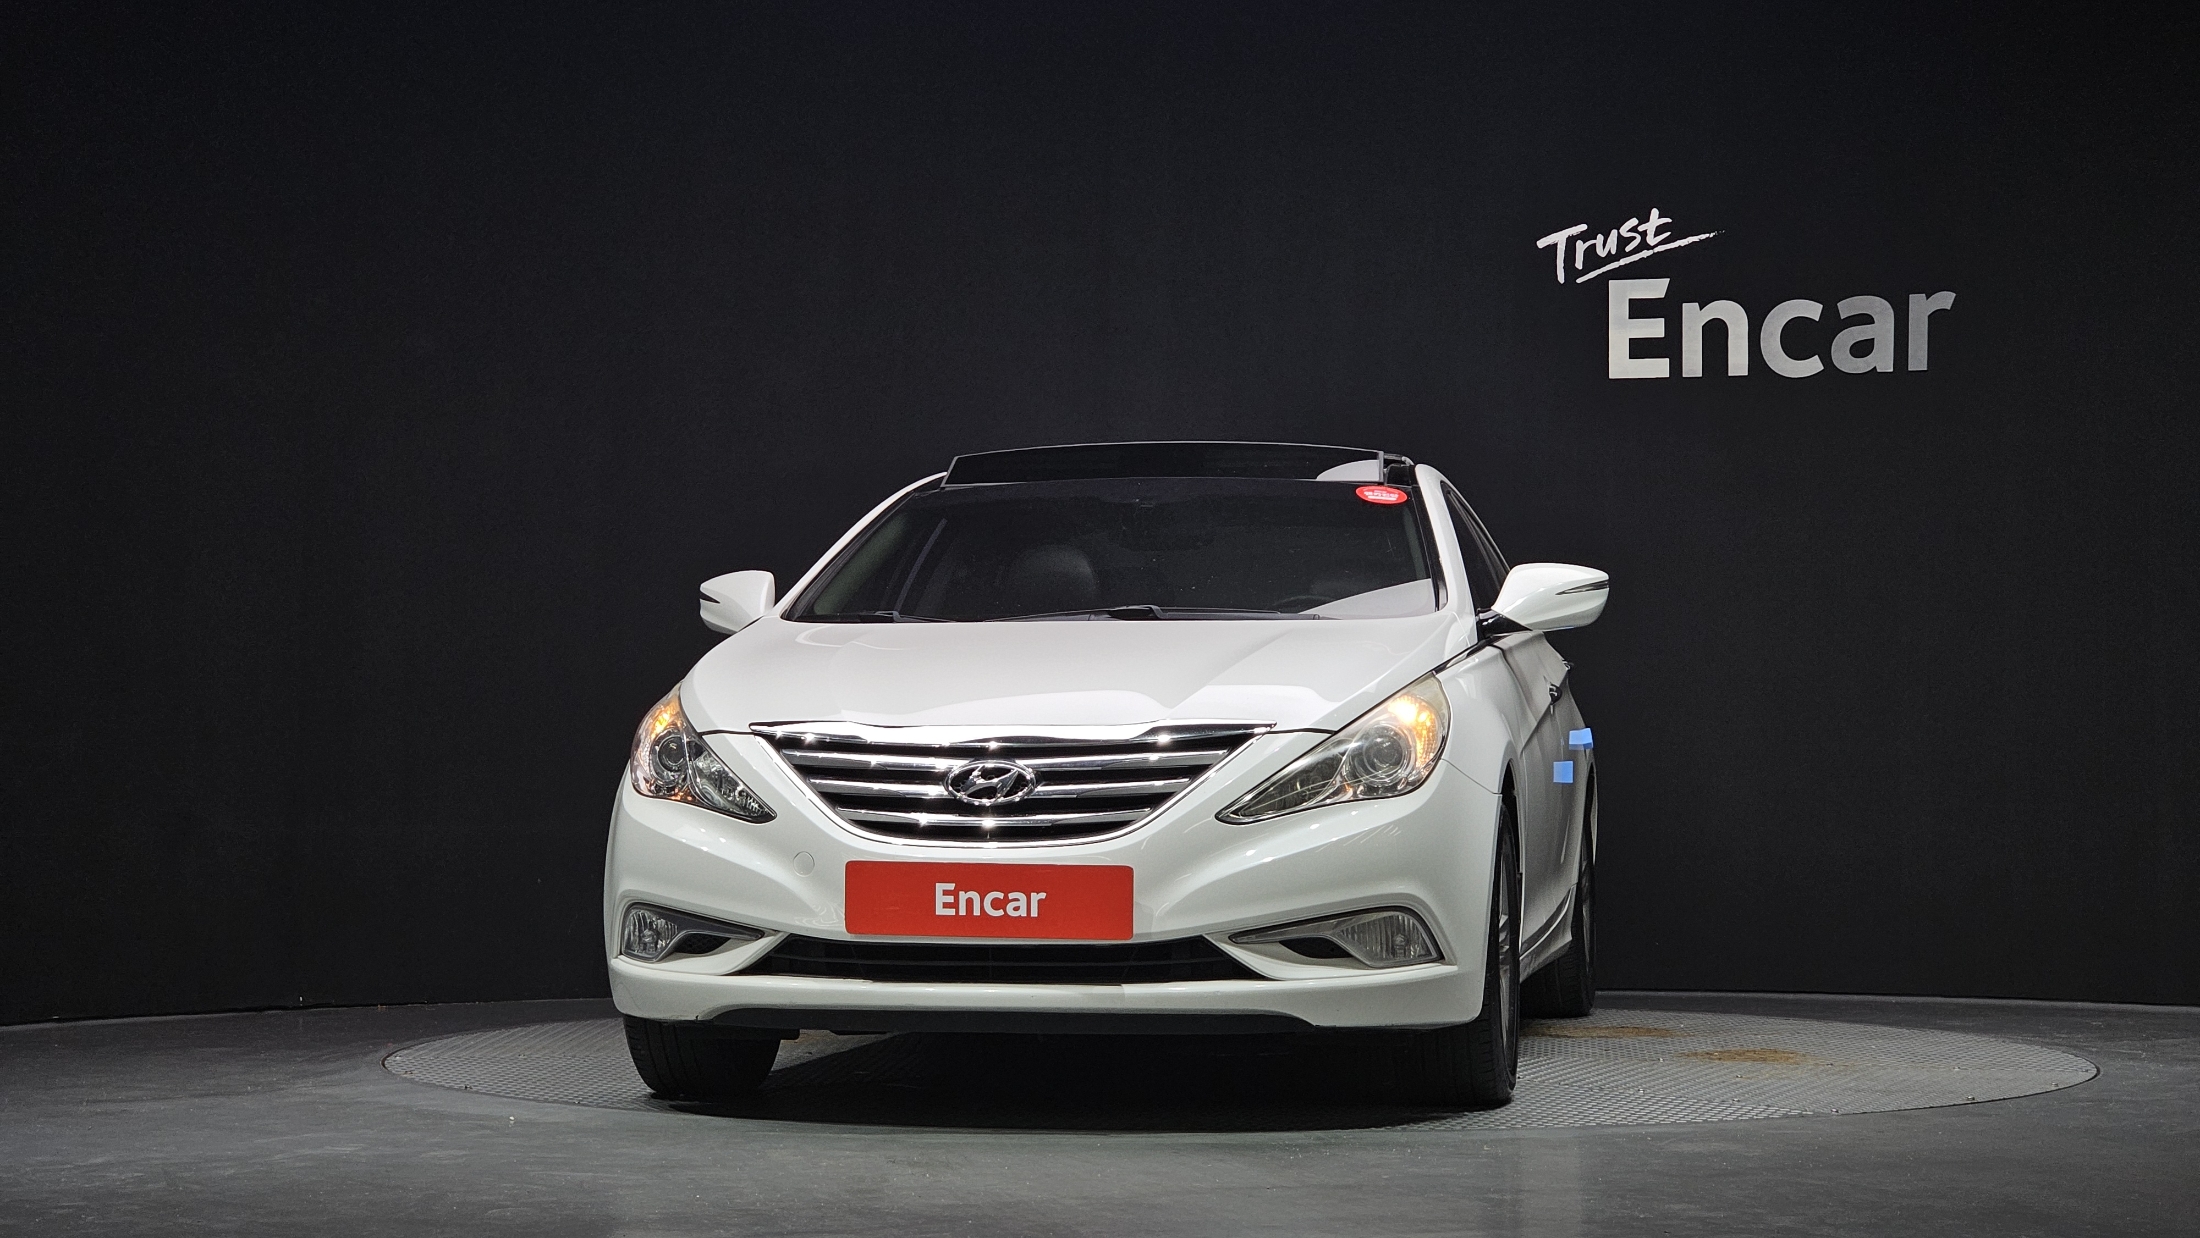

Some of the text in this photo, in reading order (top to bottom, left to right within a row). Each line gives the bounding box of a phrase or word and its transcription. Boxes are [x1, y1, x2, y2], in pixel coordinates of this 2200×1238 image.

[1537, 208, 1673, 283] Trust
[1609, 278, 1956, 379] Encar
[934, 882, 1047, 917] Encar
